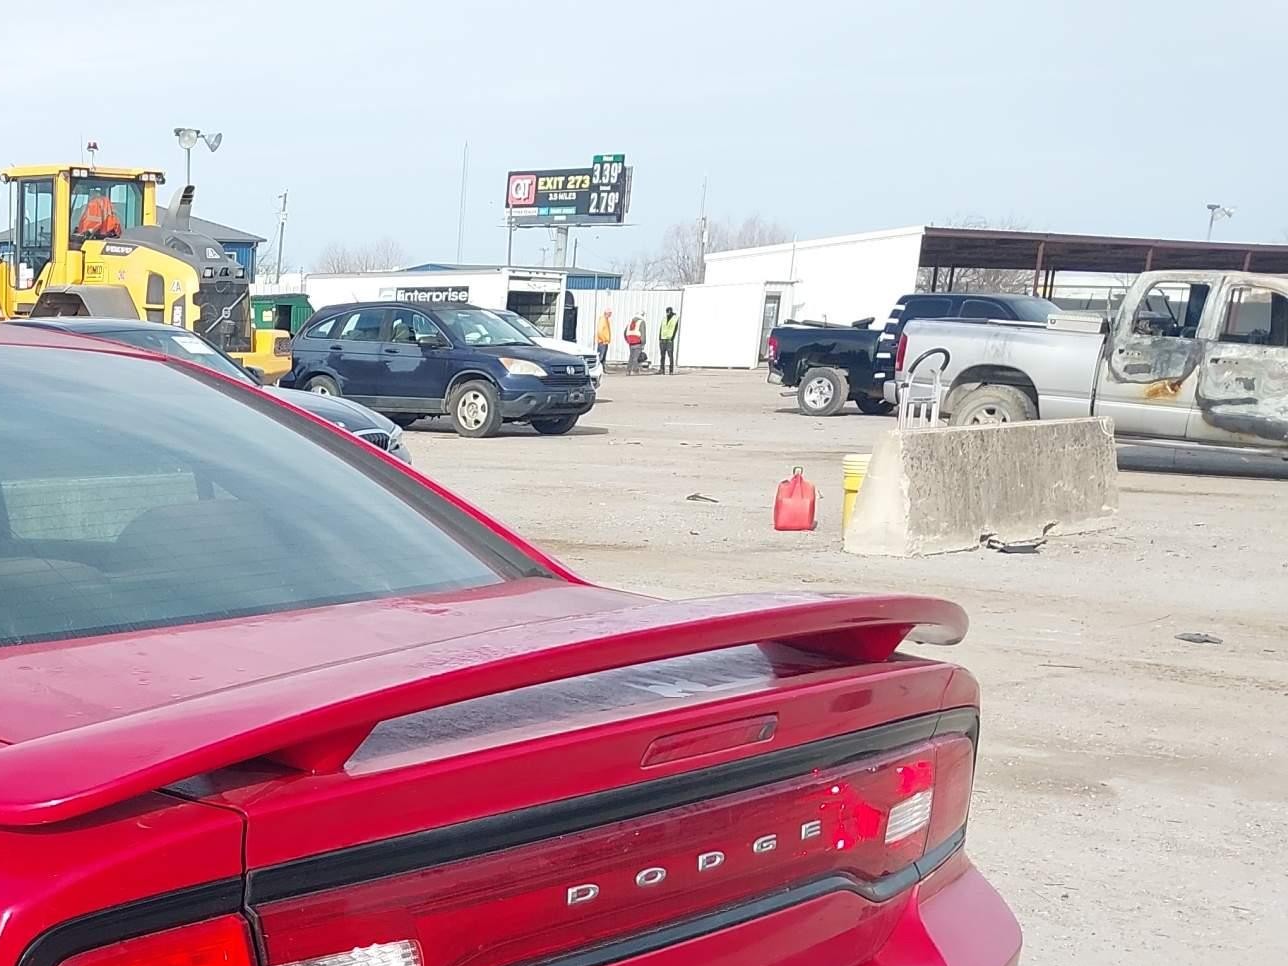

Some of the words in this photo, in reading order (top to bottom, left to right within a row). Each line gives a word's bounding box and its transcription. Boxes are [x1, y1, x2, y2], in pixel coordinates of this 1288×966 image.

[511, 178, 533, 202] QT
[537, 176, 566, 191] EXIT
[566, 174, 591, 190] 273
[558, 191, 577, 201] MILES
[567, 819, 822, 906] DODGE
